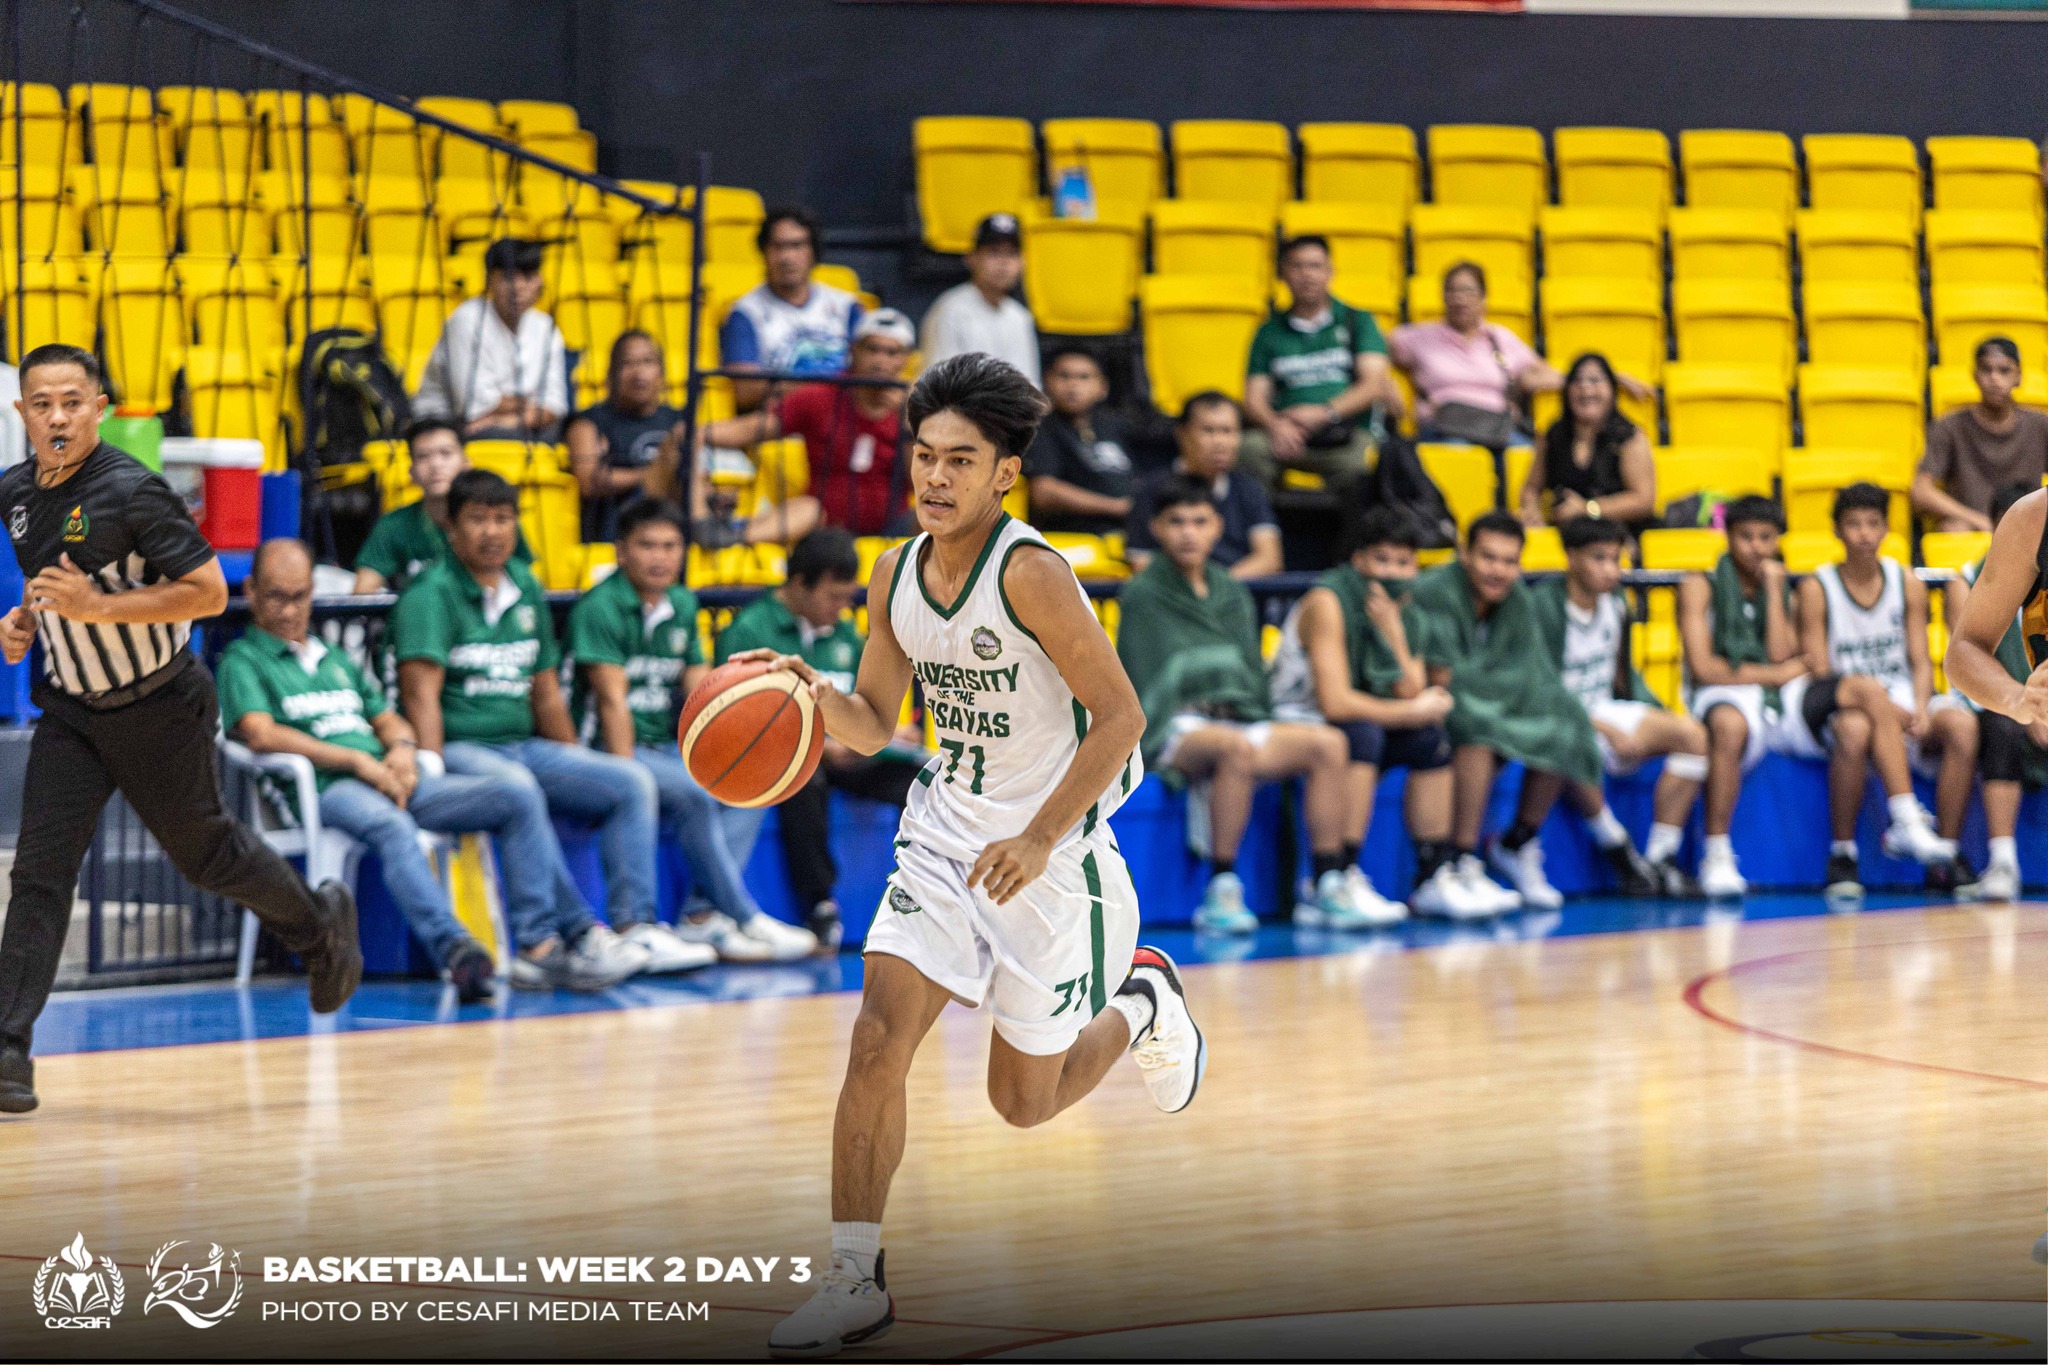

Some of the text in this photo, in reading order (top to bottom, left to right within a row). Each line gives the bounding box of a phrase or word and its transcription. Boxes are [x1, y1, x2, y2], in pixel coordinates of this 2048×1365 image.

[926, 698, 1010, 738] ISAYAS
[953, 690, 975, 706] THE
[940, 737, 985, 795] 71
[1049, 971, 1089, 1016] 71
